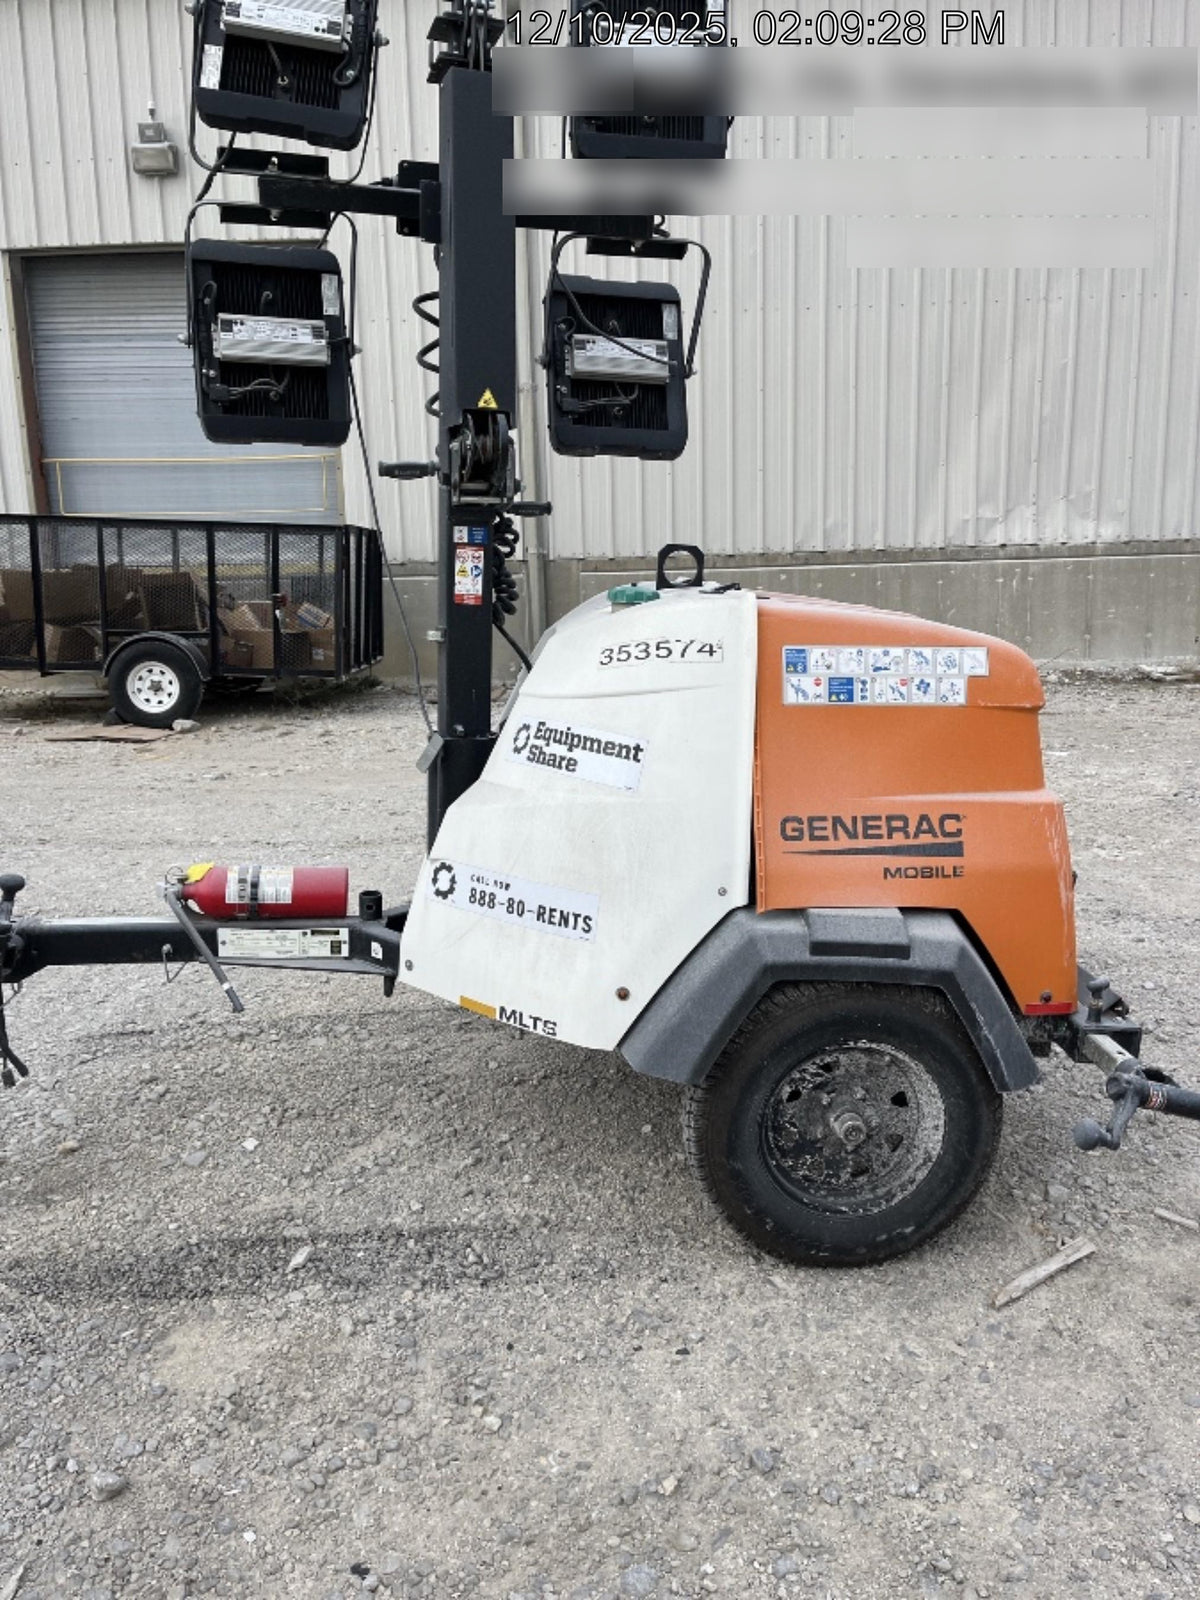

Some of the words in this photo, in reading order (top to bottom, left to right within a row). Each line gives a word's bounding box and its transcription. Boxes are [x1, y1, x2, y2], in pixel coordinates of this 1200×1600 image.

[600, 639, 717, 666] 353574
[533, 721, 644, 763] Equipment
[526, 744, 578, 773] Share
[780, 813, 963, 842] GENERAC
[883, 865, 965, 880] MOBILE
[468, 887, 593, 934] 888-80-RENTS
[499, 1005, 557, 1037] MLTS
